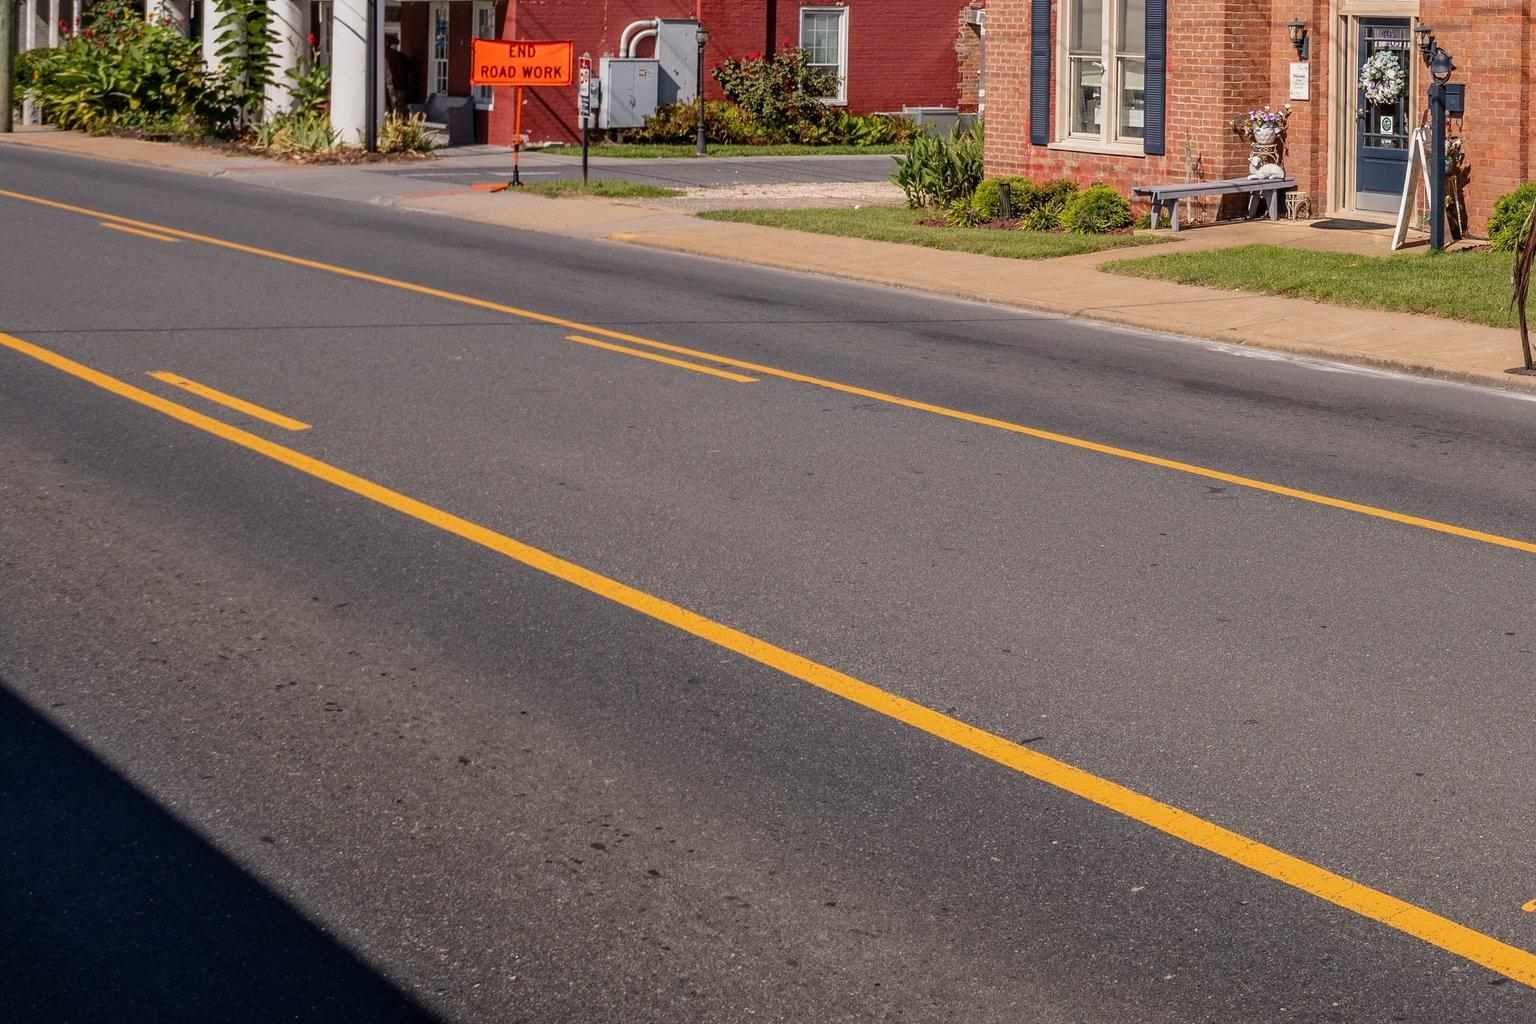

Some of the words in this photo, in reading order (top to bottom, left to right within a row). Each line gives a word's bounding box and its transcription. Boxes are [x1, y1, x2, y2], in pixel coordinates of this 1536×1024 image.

[509, 43, 536, 58] END
[480, 65, 516, 79] ROAD
[521, 66, 562, 79] WORK
